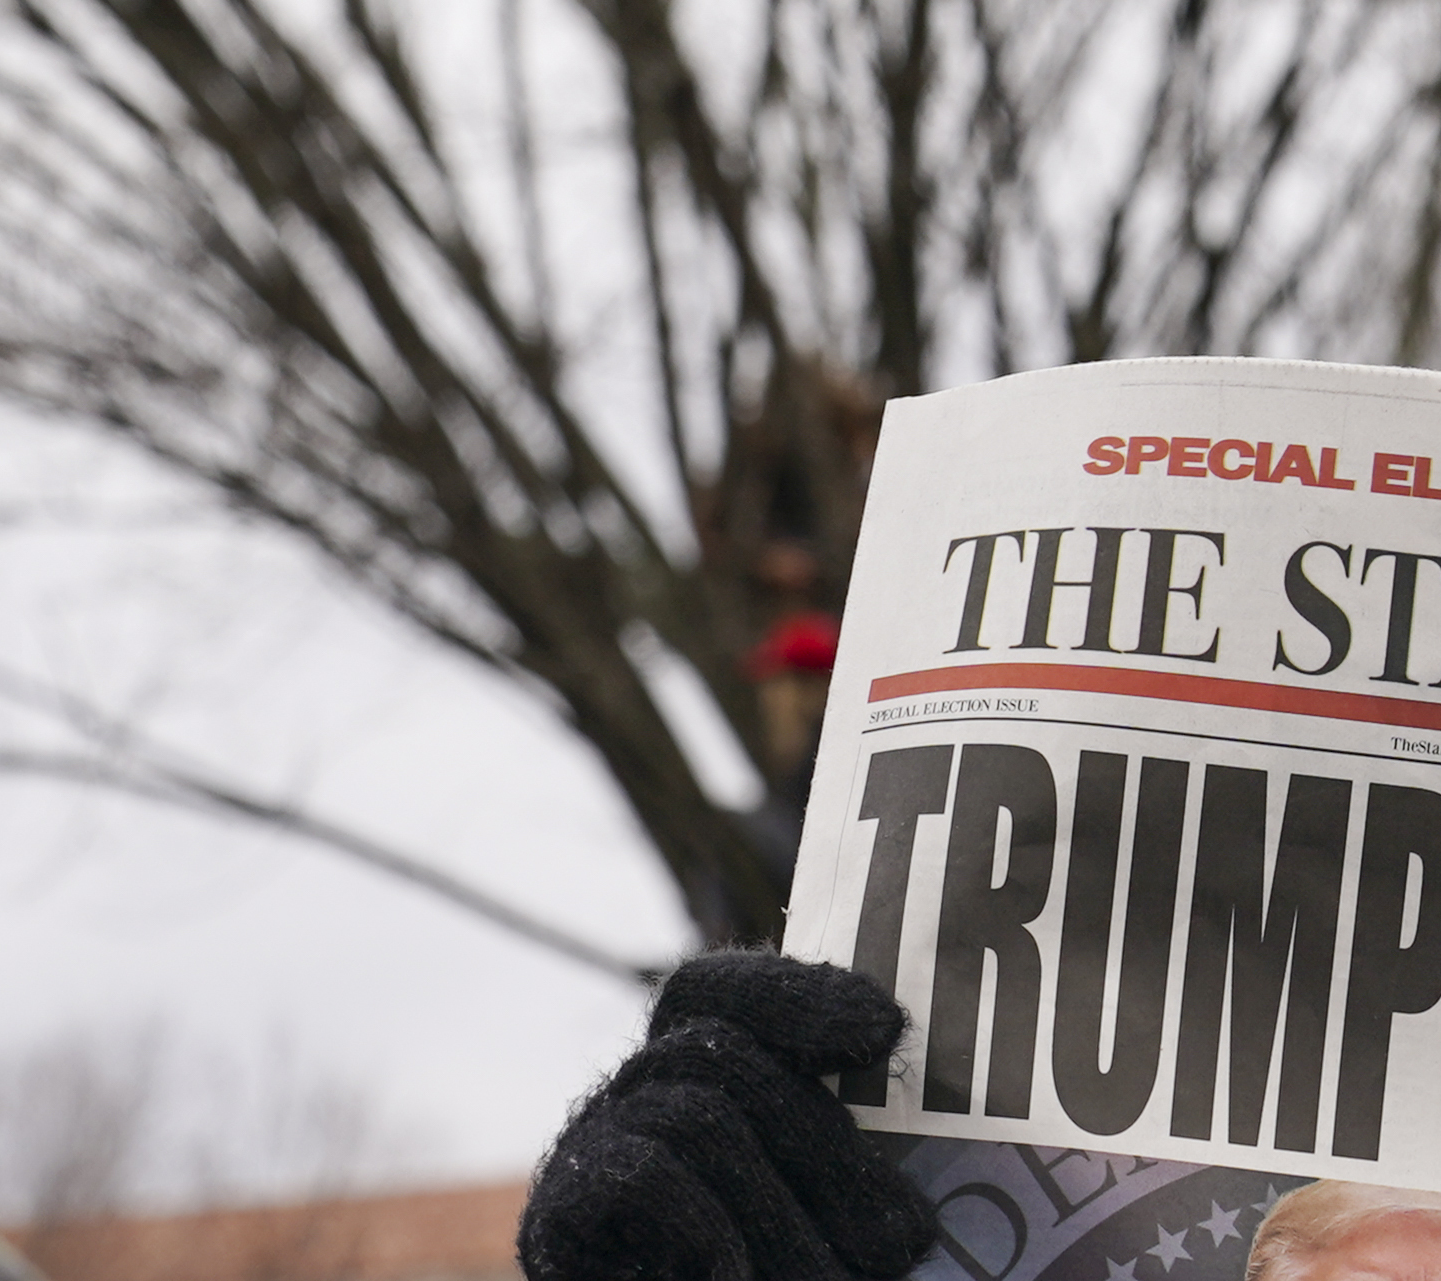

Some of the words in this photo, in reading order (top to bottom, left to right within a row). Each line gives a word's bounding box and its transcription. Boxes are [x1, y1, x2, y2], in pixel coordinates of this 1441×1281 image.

[1083, 434, 1355, 492] SPECIAL
[943, 527, 1227, 658] THE
[869, 703, 919, 724] SPECIAL
[922, 700, 991, 715] ELECTION
[995, 698, 1040, 713] ISSUE
